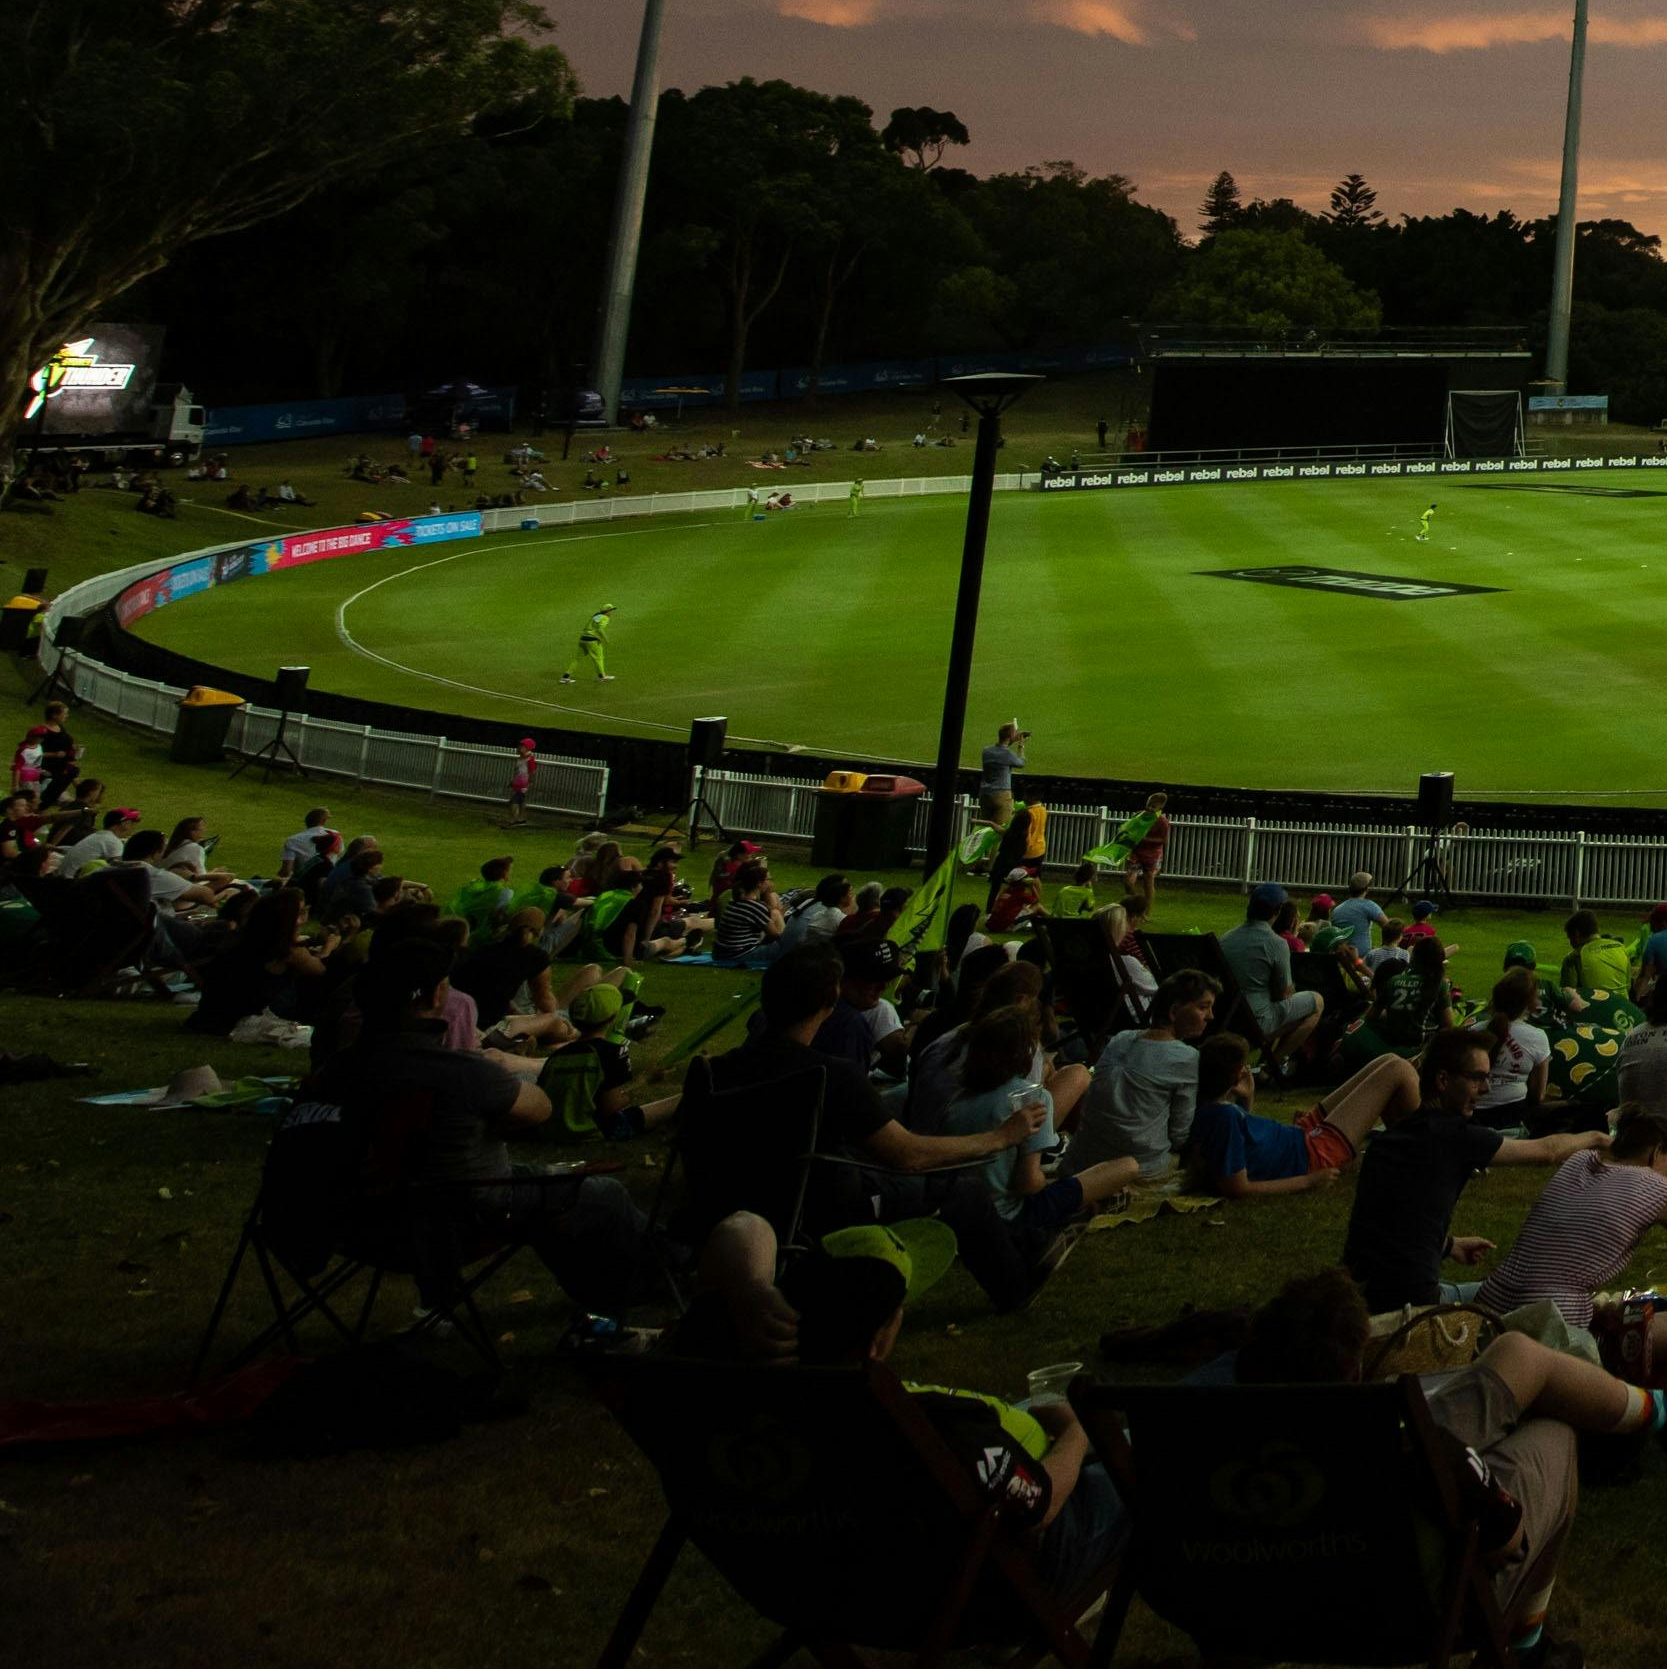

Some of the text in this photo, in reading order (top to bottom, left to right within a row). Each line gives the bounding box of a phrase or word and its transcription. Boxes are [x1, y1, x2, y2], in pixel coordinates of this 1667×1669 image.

[59, 366, 132, 386] THUNDER
[1044, 476, 1075, 489] rebel
[1081, 474, 1111, 487] rebel
[1117, 472, 1148, 484] rebel
[1154, 470, 1184, 483] rebel
[1190, 468, 1220, 481] rebel
[1226, 467, 1257, 479] rebel
[1263, 465, 1294, 477] rebel
[1299, 464, 1330, 476] rebel
[1335, 463, 1366, 475] rebel
[1371, 463, 1401, 474] rebel
[1406, 462, 1435, 473] rebel
[1441, 461, 1470, 472] rebel
[1475, 460, 1504, 471] rebel
[1509, 459, 1537, 470] rebel
[1543, 458, 1570, 469] rebel
[1576, 457, 1603, 468] rebel
[1608, 456, 1636, 467] rebel
